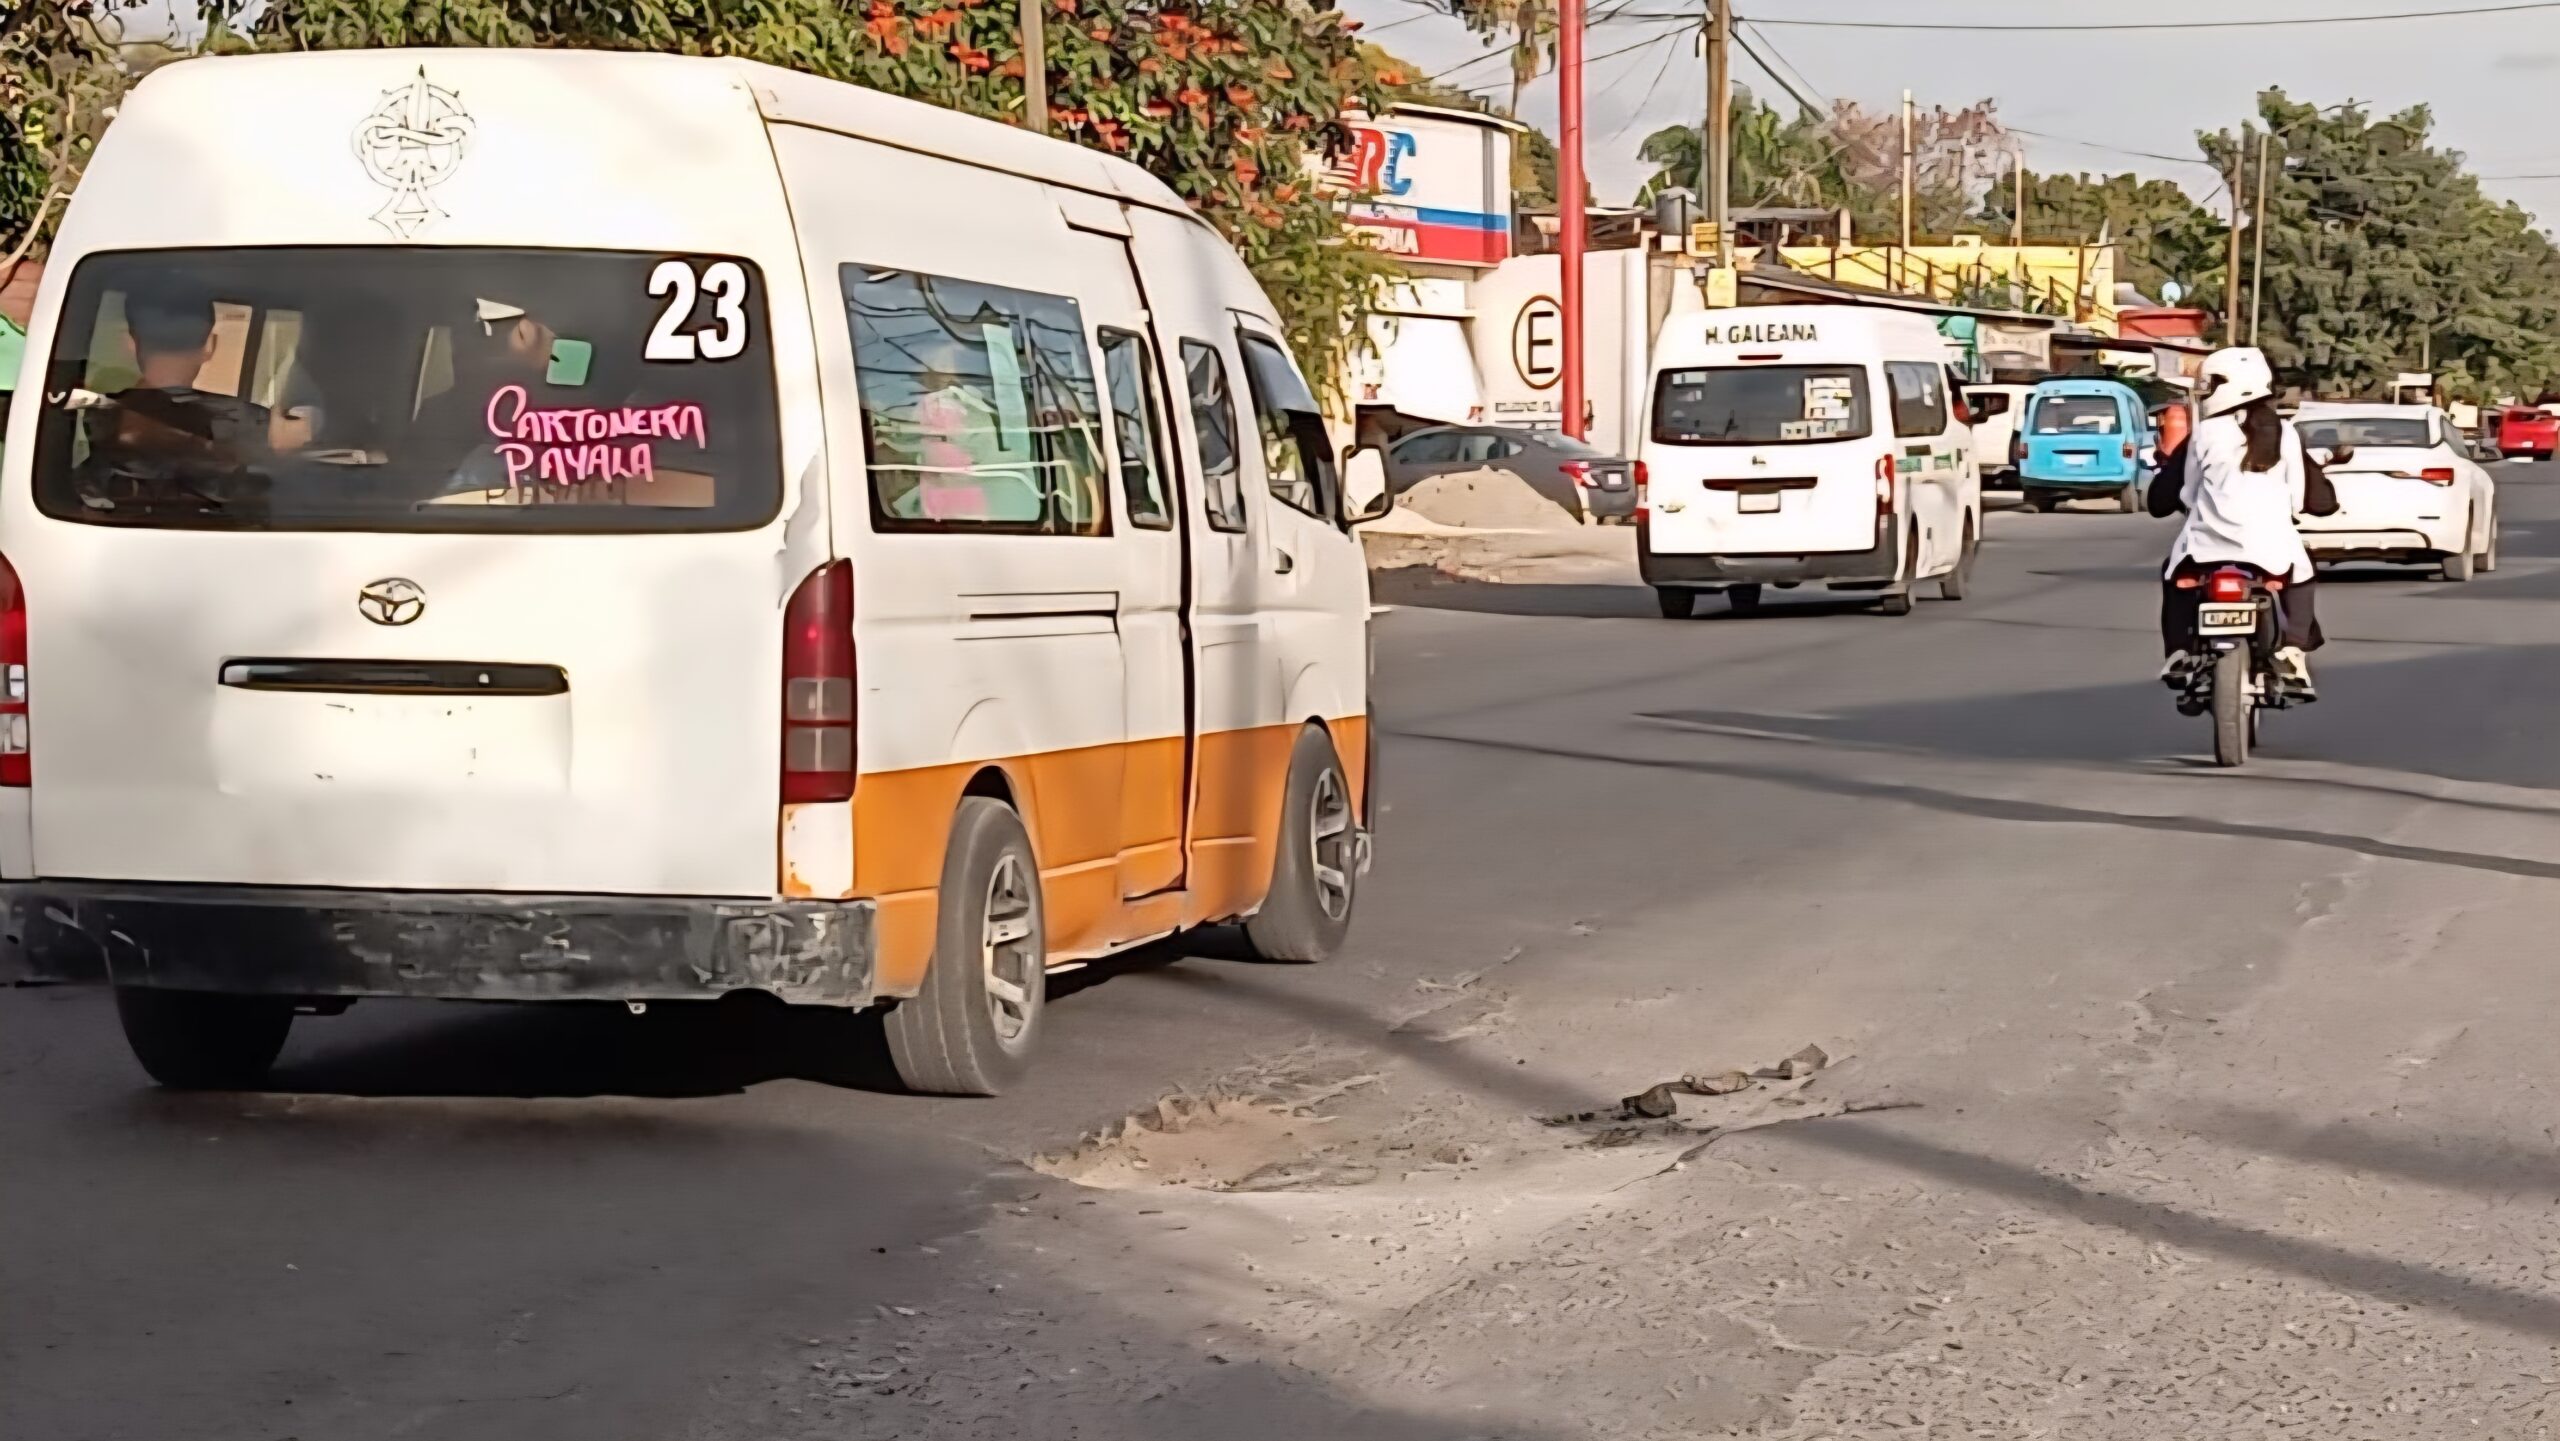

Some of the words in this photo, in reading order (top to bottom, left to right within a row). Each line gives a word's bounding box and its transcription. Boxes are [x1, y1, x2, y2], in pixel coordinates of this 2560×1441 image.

[644, 260, 747, 361] 23
[1705, 325, 1724, 345] H.
[1728, 323, 1818, 343] GALEANA
[1528, 311, 1555, 374] E
[494, 443, 654, 488] PAYALA
